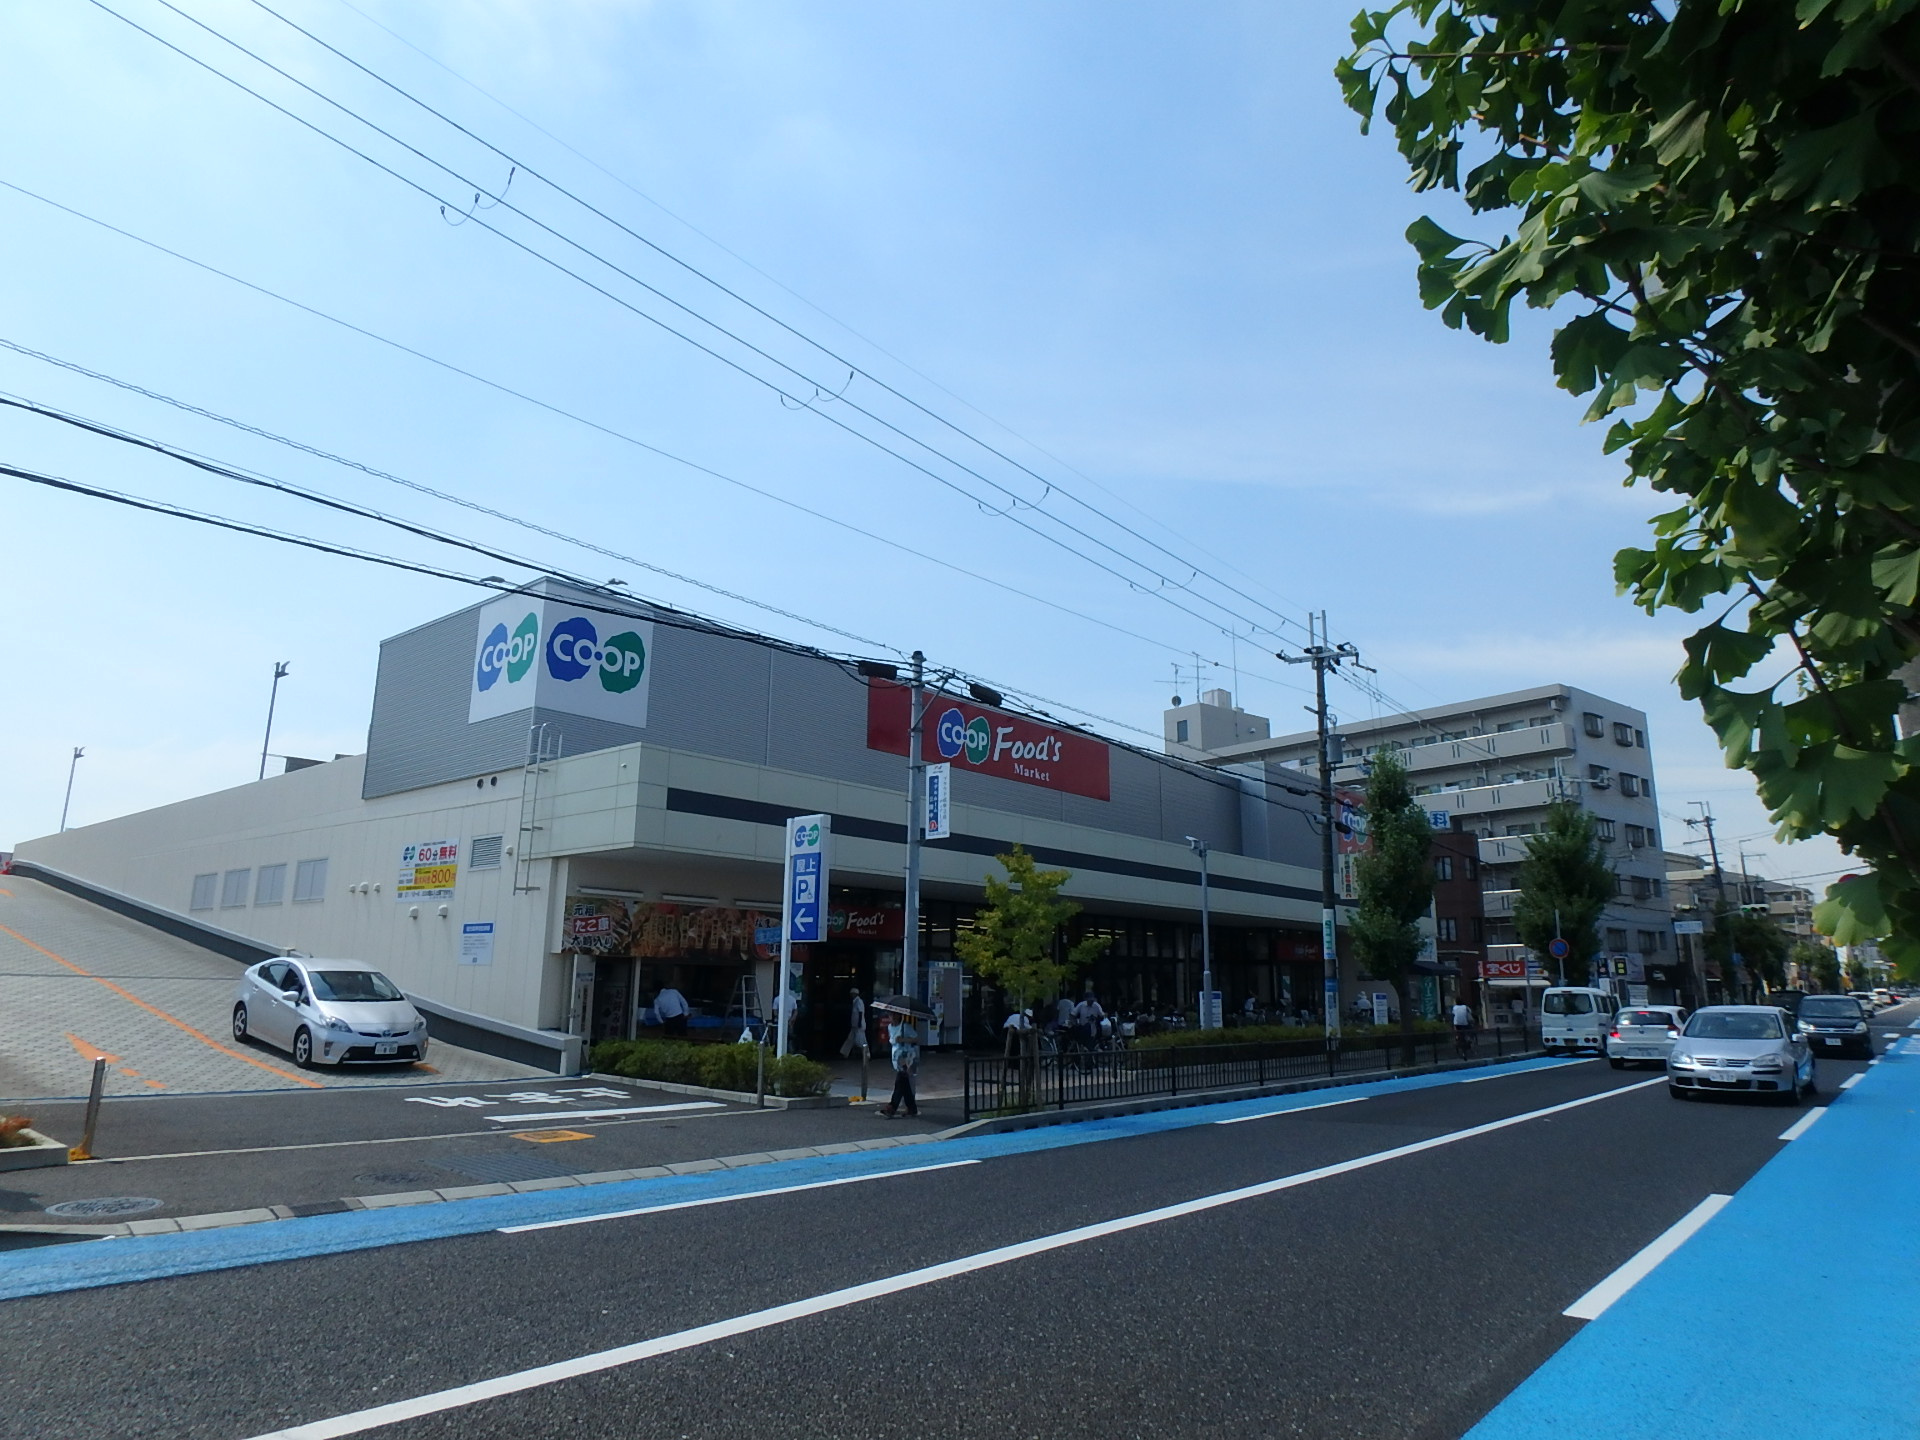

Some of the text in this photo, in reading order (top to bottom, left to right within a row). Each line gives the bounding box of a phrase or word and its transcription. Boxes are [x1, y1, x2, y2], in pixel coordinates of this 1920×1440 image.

[992, 726, 1062, 762] Food's
[1013, 762, 1050, 781] Market
[418, 845, 457, 861] 60分無料
[795, 857, 817, 873] 屋上
[798, 879, 809, 900] P
[846, 911, 885, 931] Food's
[1486, 963, 1521, 975] 宝くじ
